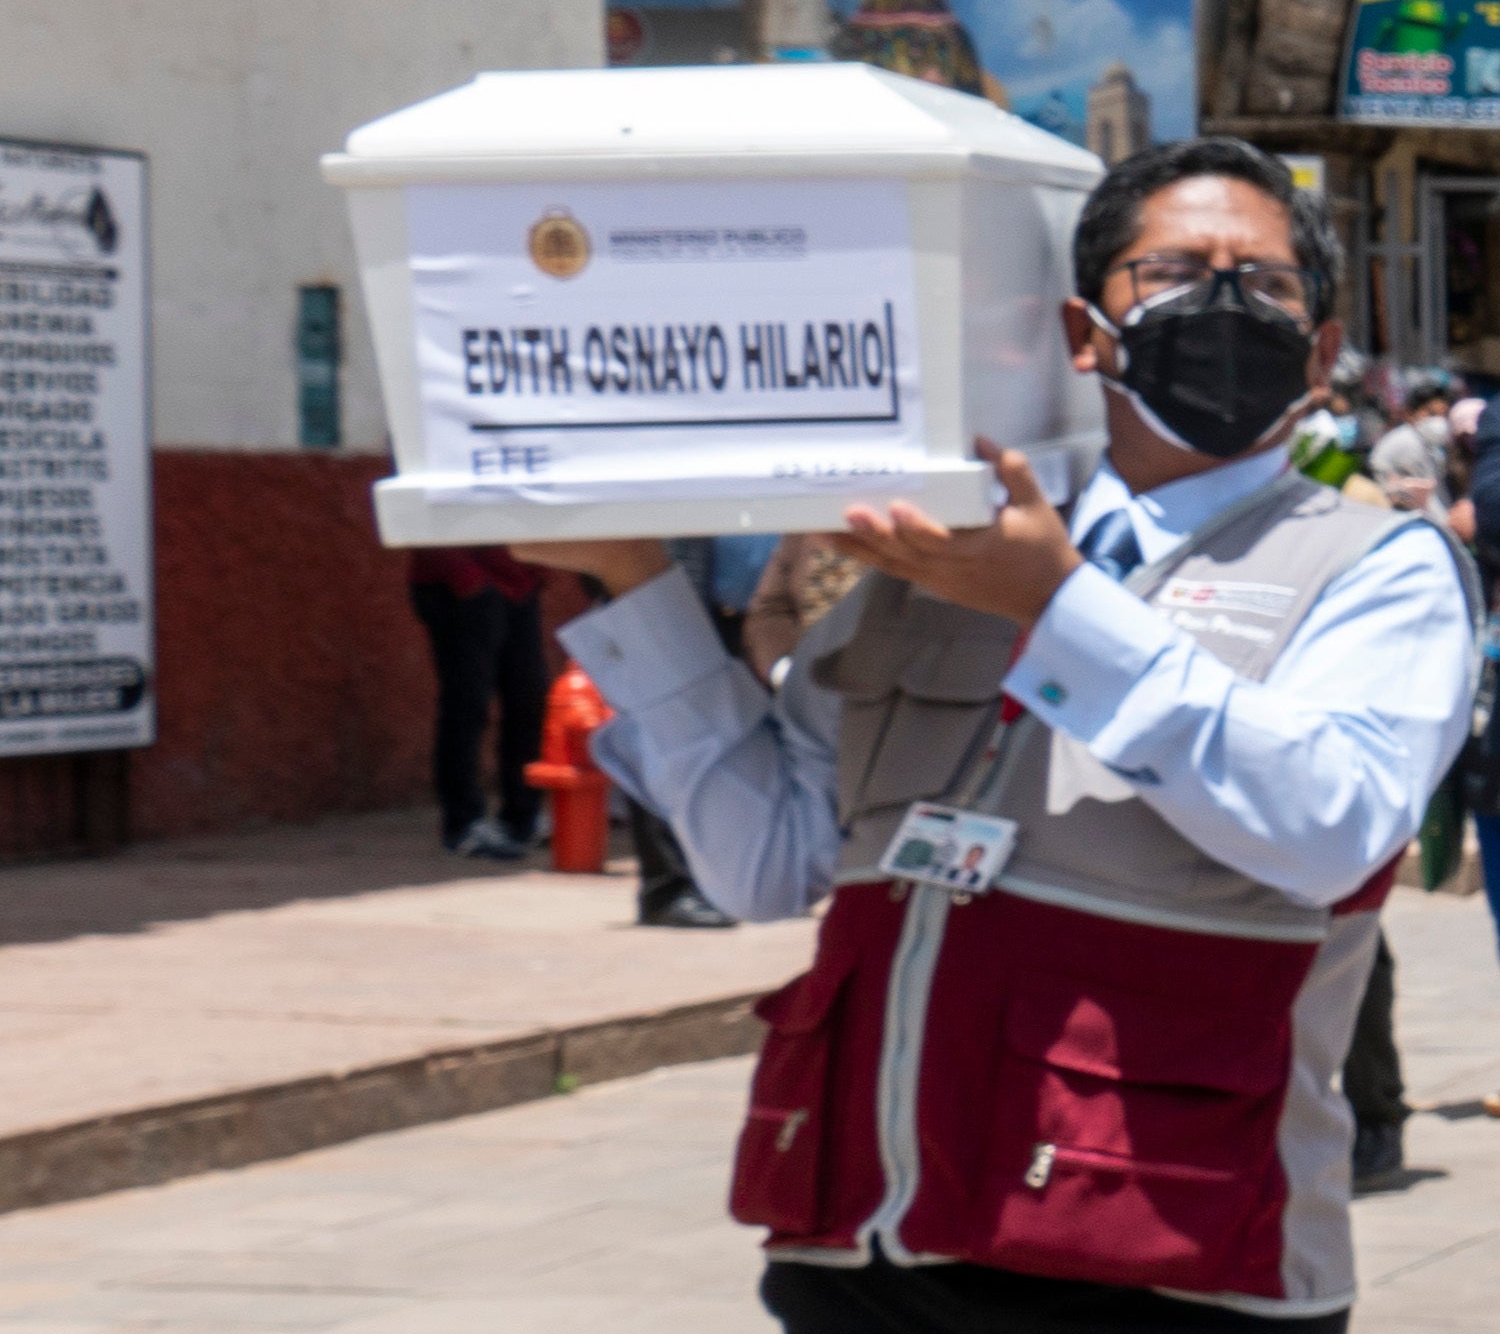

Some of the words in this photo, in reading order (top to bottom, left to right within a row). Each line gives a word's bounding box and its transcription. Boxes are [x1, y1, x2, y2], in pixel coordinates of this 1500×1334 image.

[462, 326, 574, 395] EDITH
[584, 323, 729, 394] OSNAYO
[740, 319, 884, 392] HILARIO
[470, 445, 553, 489] EFE
